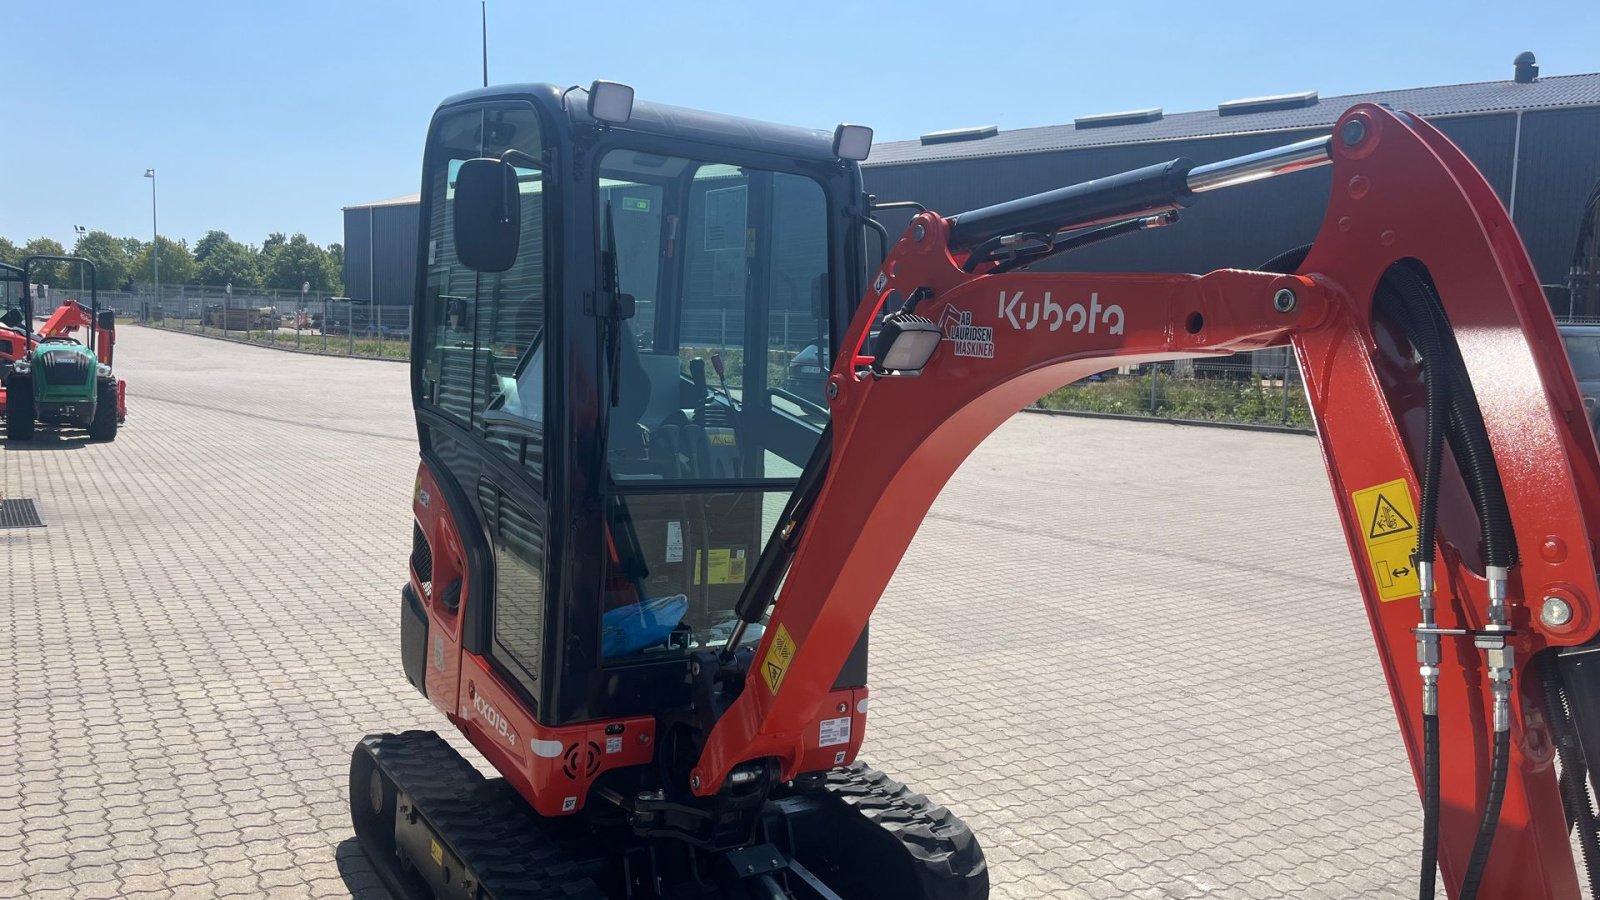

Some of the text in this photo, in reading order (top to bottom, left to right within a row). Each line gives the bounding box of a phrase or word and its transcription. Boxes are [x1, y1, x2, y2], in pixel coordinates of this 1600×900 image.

[960, 312, 971, 326] AB
[998, 291, 1125, 336] Kubota
[951, 326, 992, 342] LAURIDSEN
[956, 341, 994, 357] MASKINER
